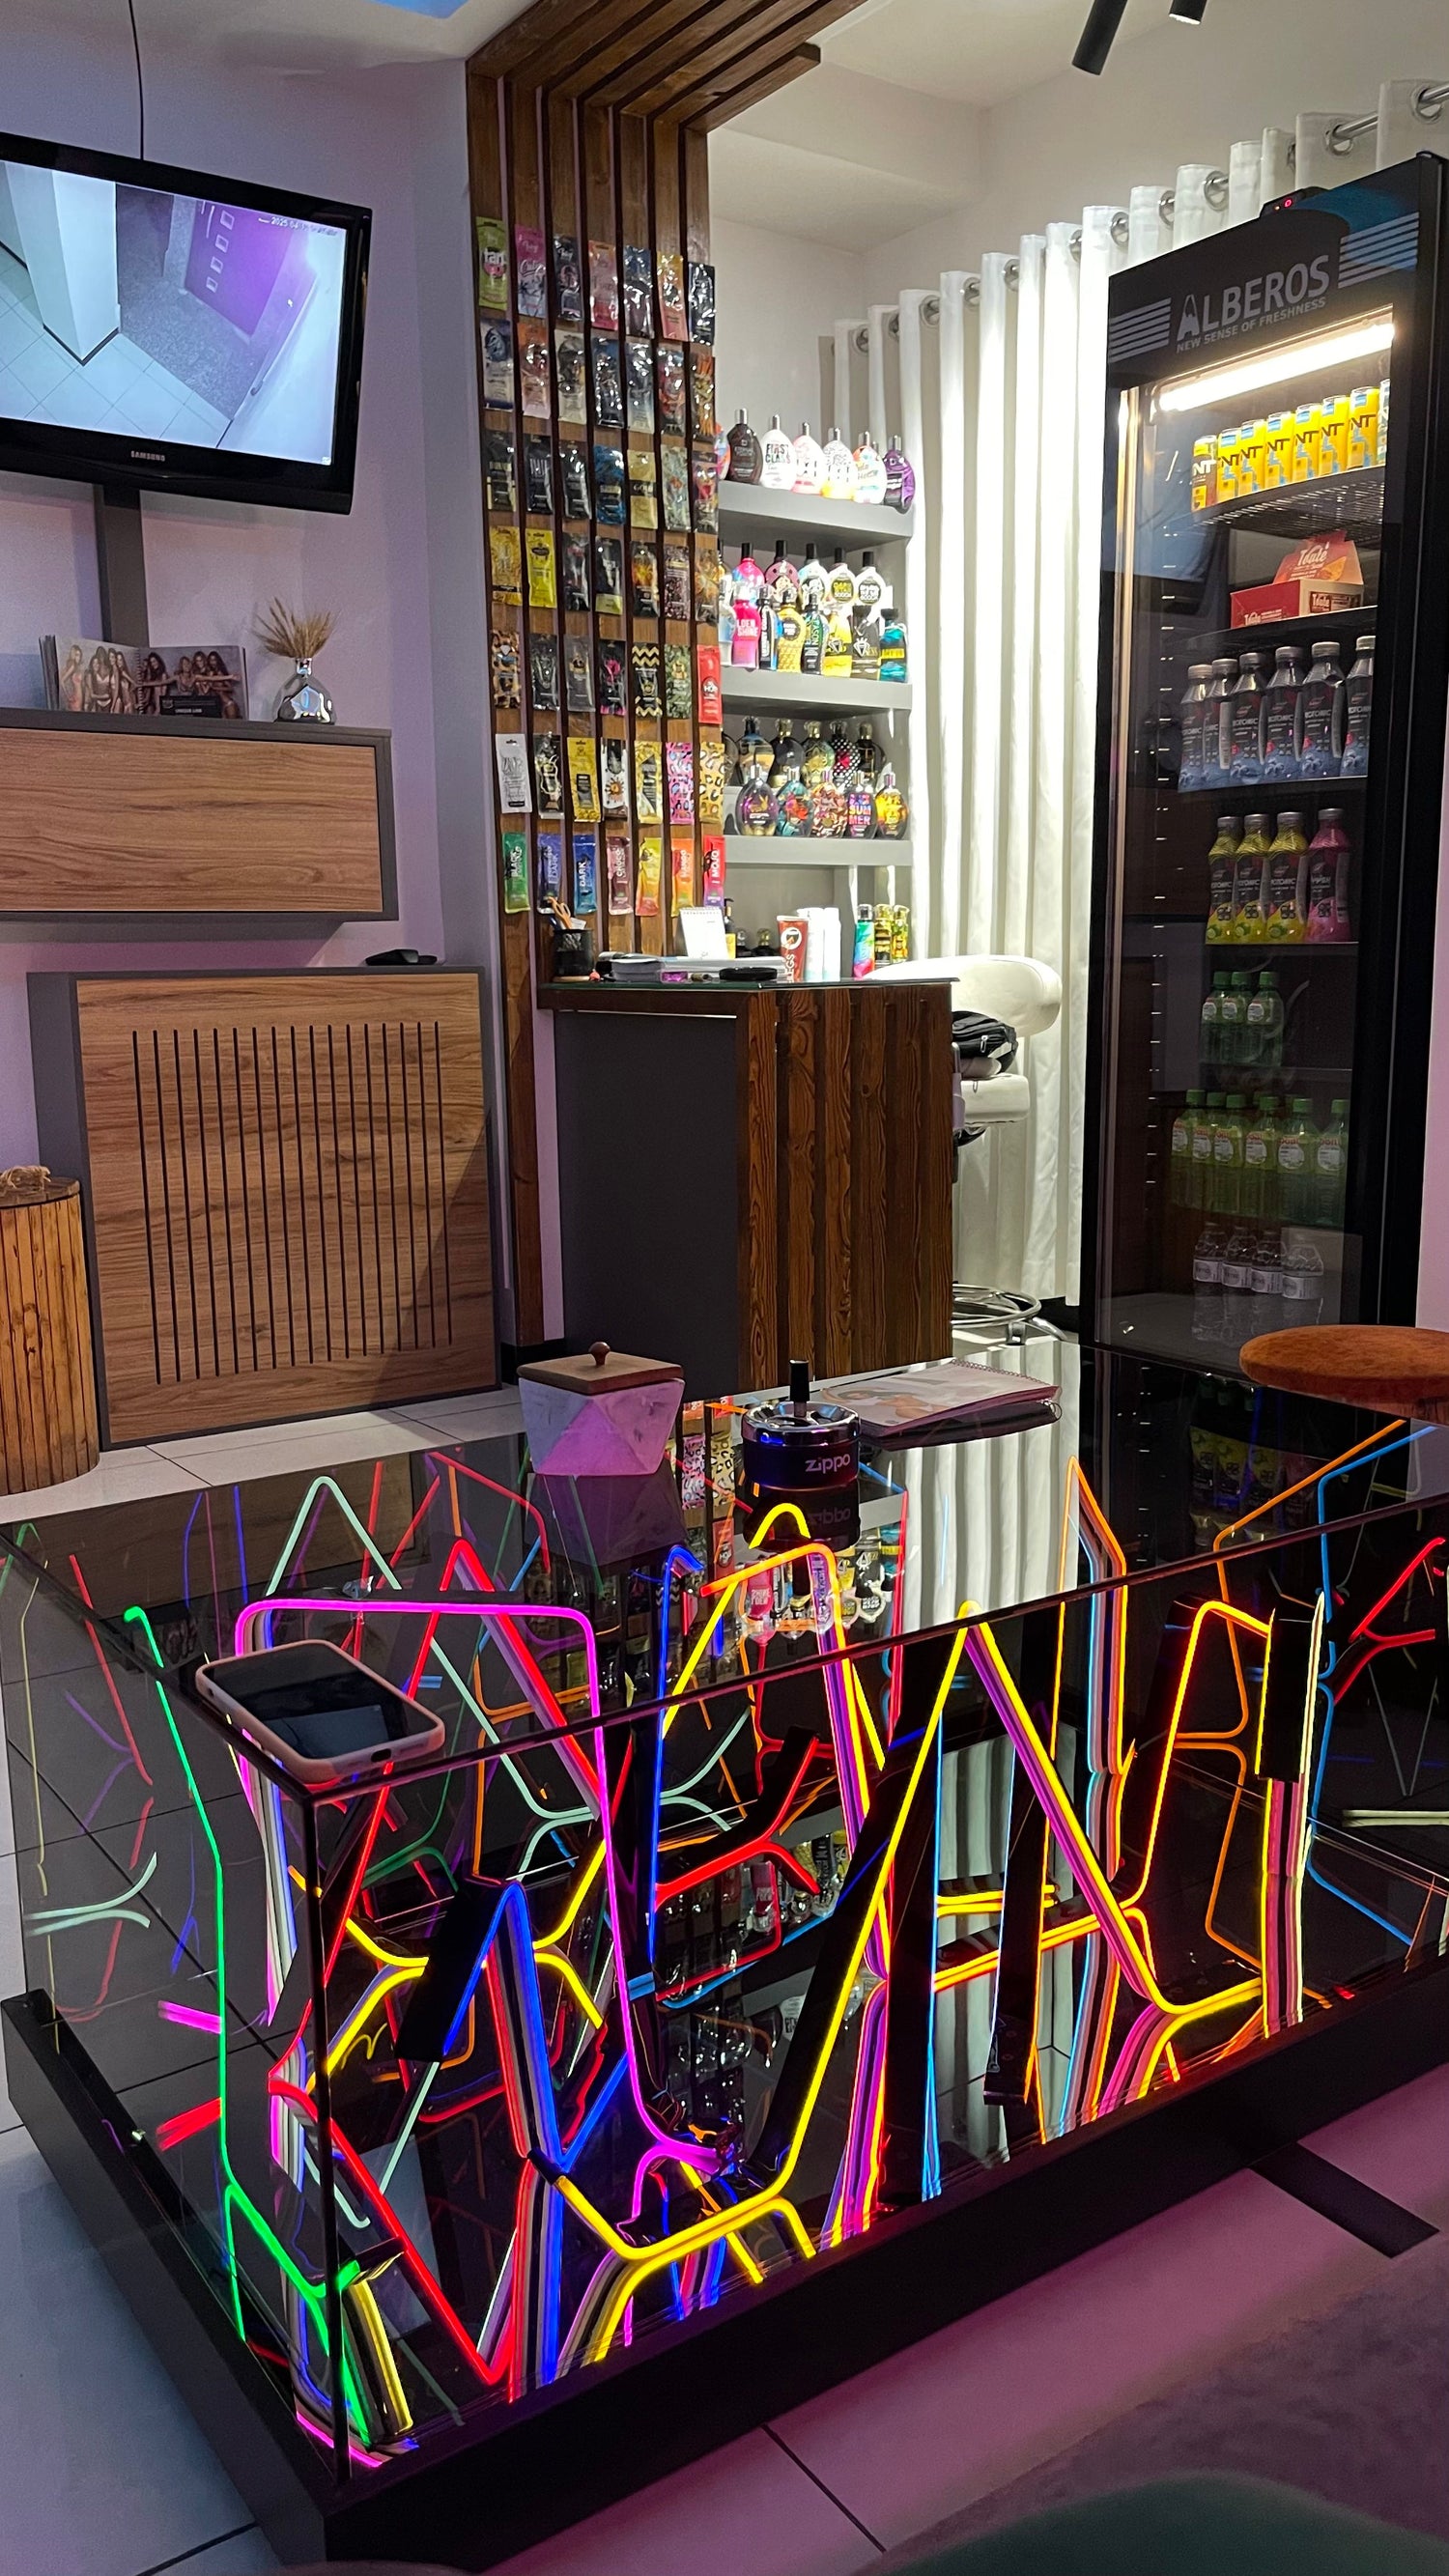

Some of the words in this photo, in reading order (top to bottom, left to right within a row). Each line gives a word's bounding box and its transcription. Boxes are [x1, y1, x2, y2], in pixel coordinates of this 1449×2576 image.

[1177, 255, 1330, 341] ALBEROS
[1176, 338, 1201, 354] NEW
[1204, 325, 1238, 345] SENSE
[1241, 319, 1256, 332] OF
[1259, 297, 1326, 327] FRESHNESS
[710, 850, 720, 878] MOJO
[805, 1454, 851, 1474] zippo
